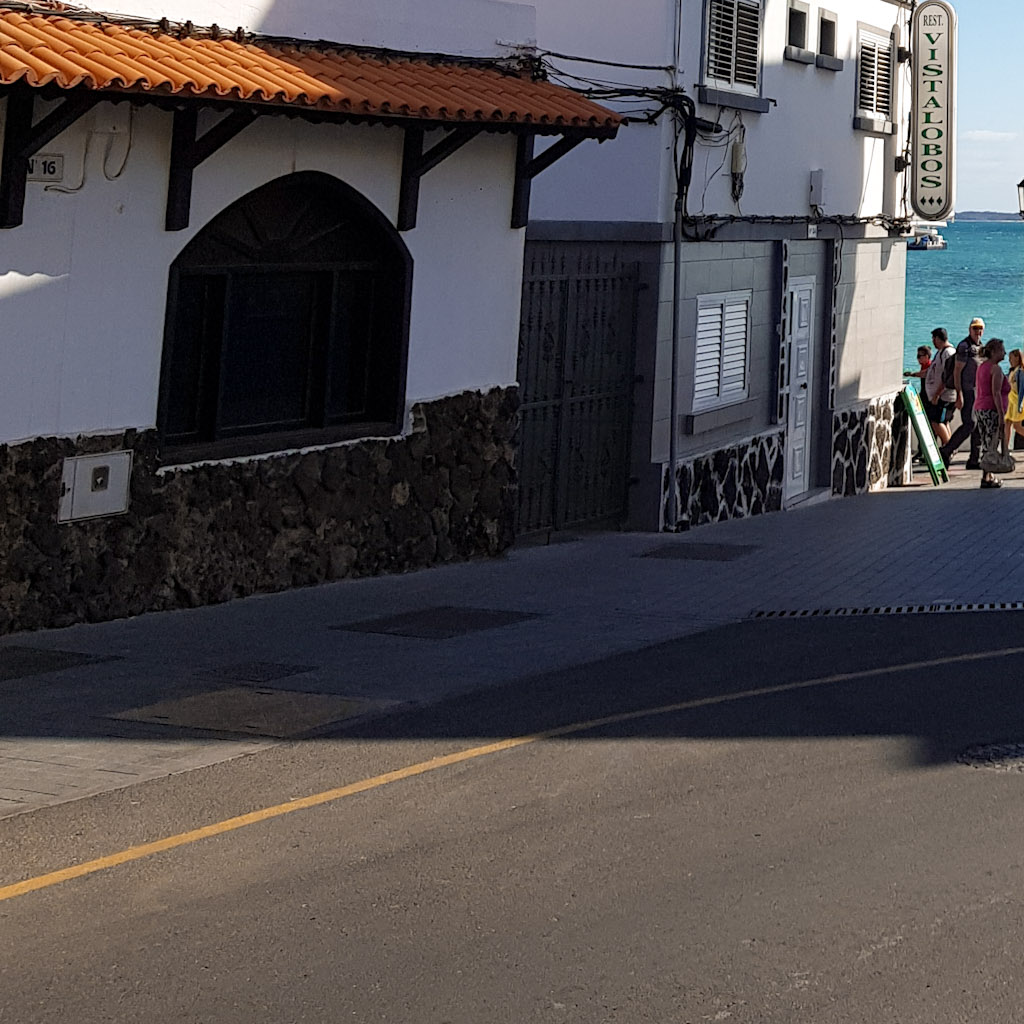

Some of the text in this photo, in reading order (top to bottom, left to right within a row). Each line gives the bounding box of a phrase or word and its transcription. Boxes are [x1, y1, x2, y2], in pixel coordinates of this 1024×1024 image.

[923, 14, 944, 26] REST.
[920, 32, 944, 188] VISTALOBOS
[41, 160, 56, 175] 16
